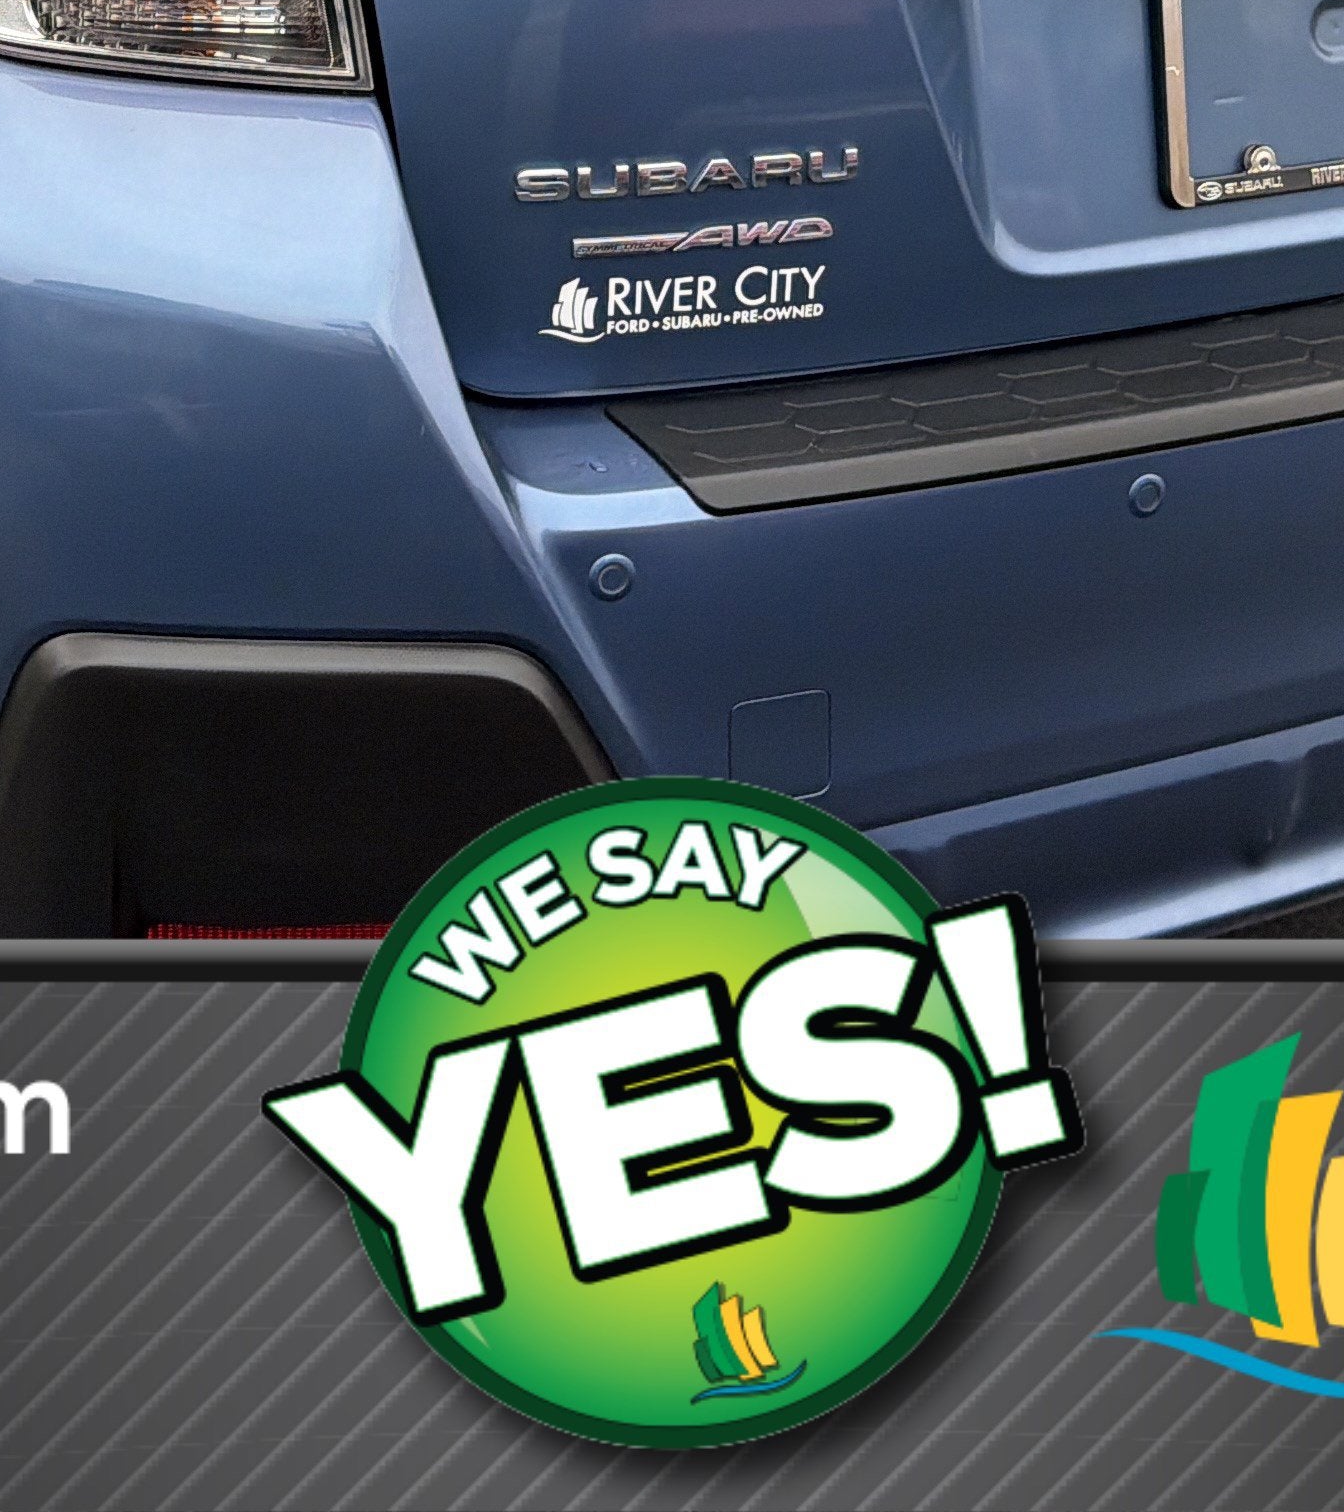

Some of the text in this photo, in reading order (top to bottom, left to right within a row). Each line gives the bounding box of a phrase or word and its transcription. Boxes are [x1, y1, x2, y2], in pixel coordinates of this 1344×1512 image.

[514, 147, 858, 202] SUBARU
[1224, 175, 1284, 195] SUBARU
[670, 217, 835, 252] AWD
[607, 265, 826, 317] RIVER CITY
[606, 303, 824, 335] FORD SUBARU PRE-OWNED
